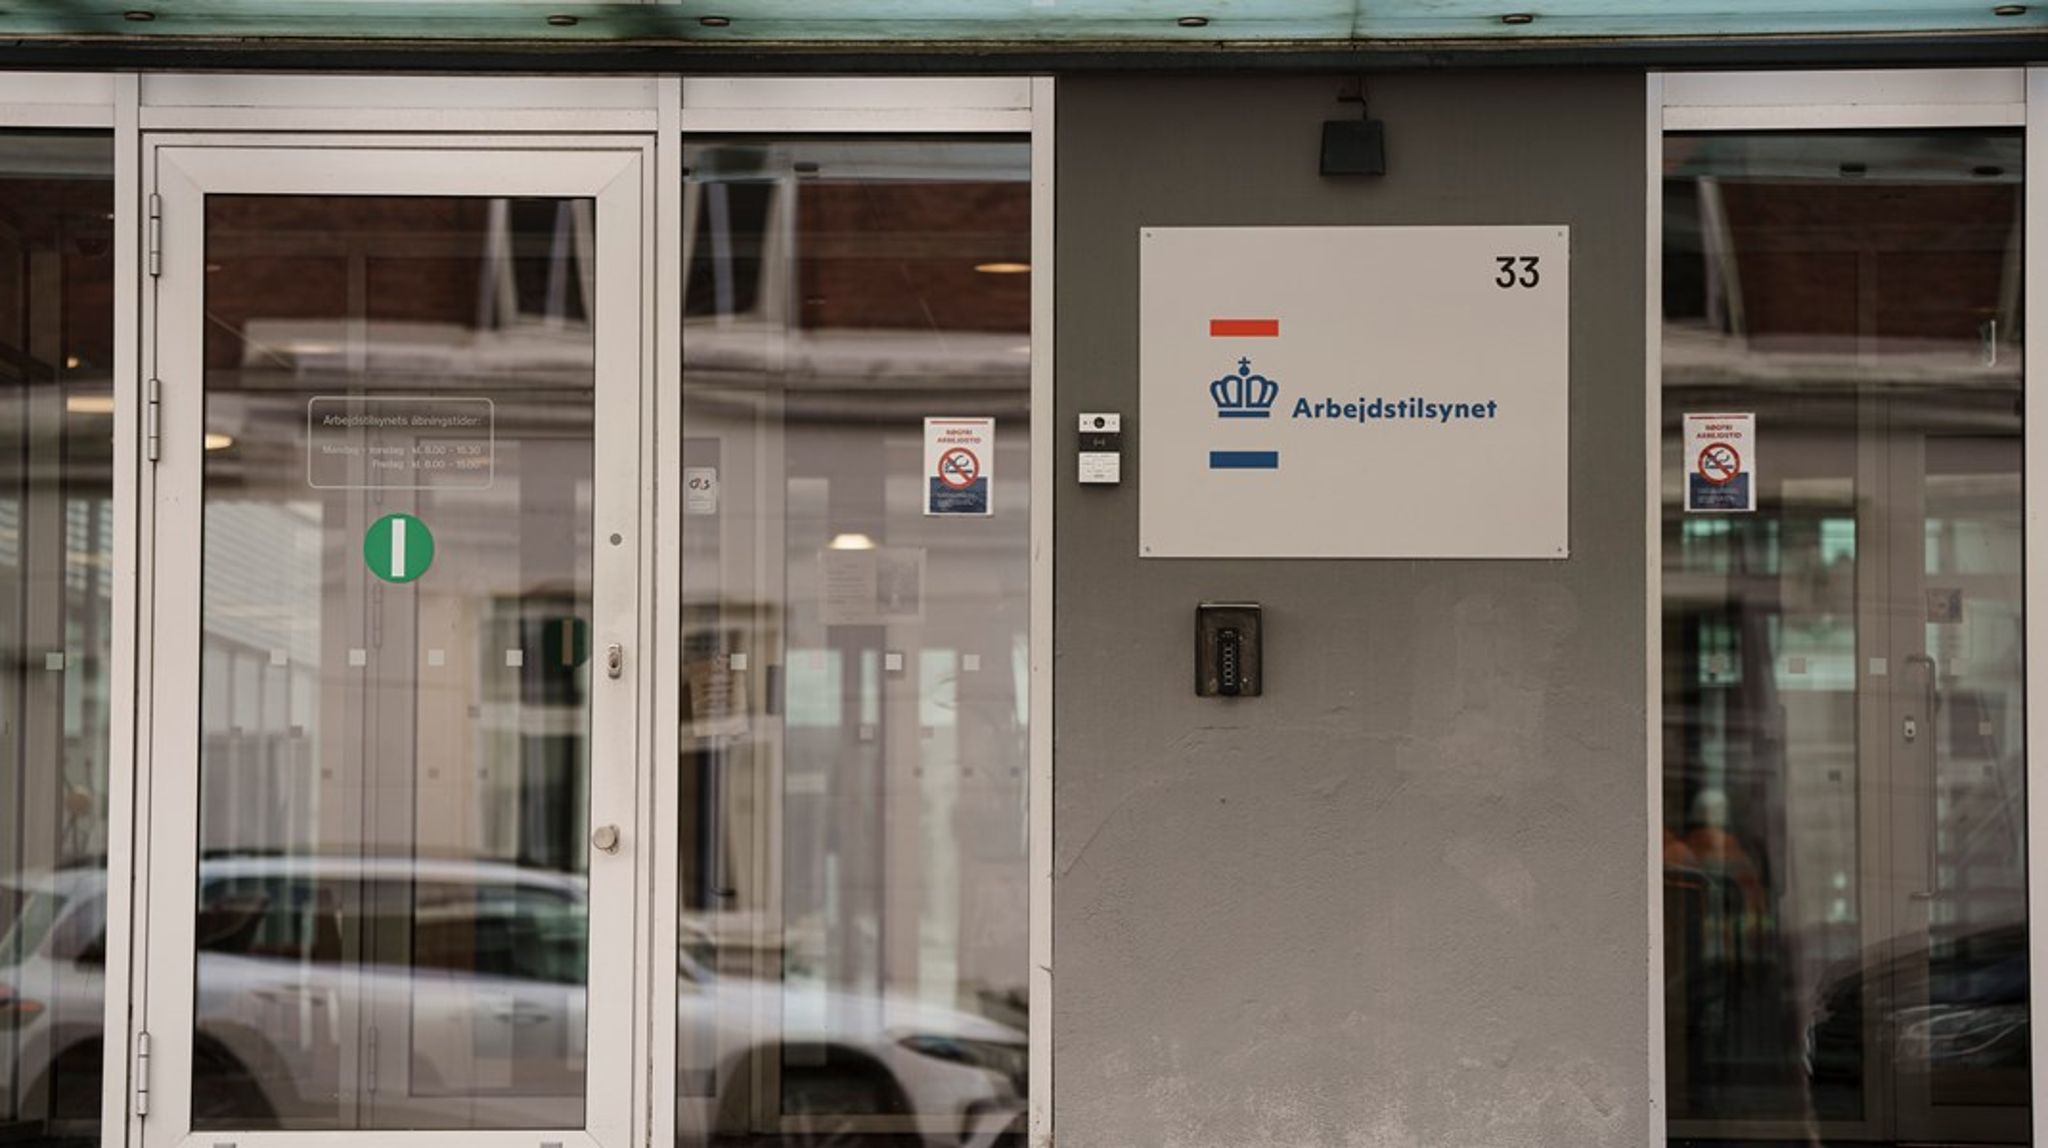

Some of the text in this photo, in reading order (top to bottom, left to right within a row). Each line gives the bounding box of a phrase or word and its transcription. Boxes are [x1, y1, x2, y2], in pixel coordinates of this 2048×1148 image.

[1495, 255, 1540, 288] 33
[323, 414, 408, 428] Arbejdstilsynets
[1292, 397, 1498, 424] Arbejdstilsynet
